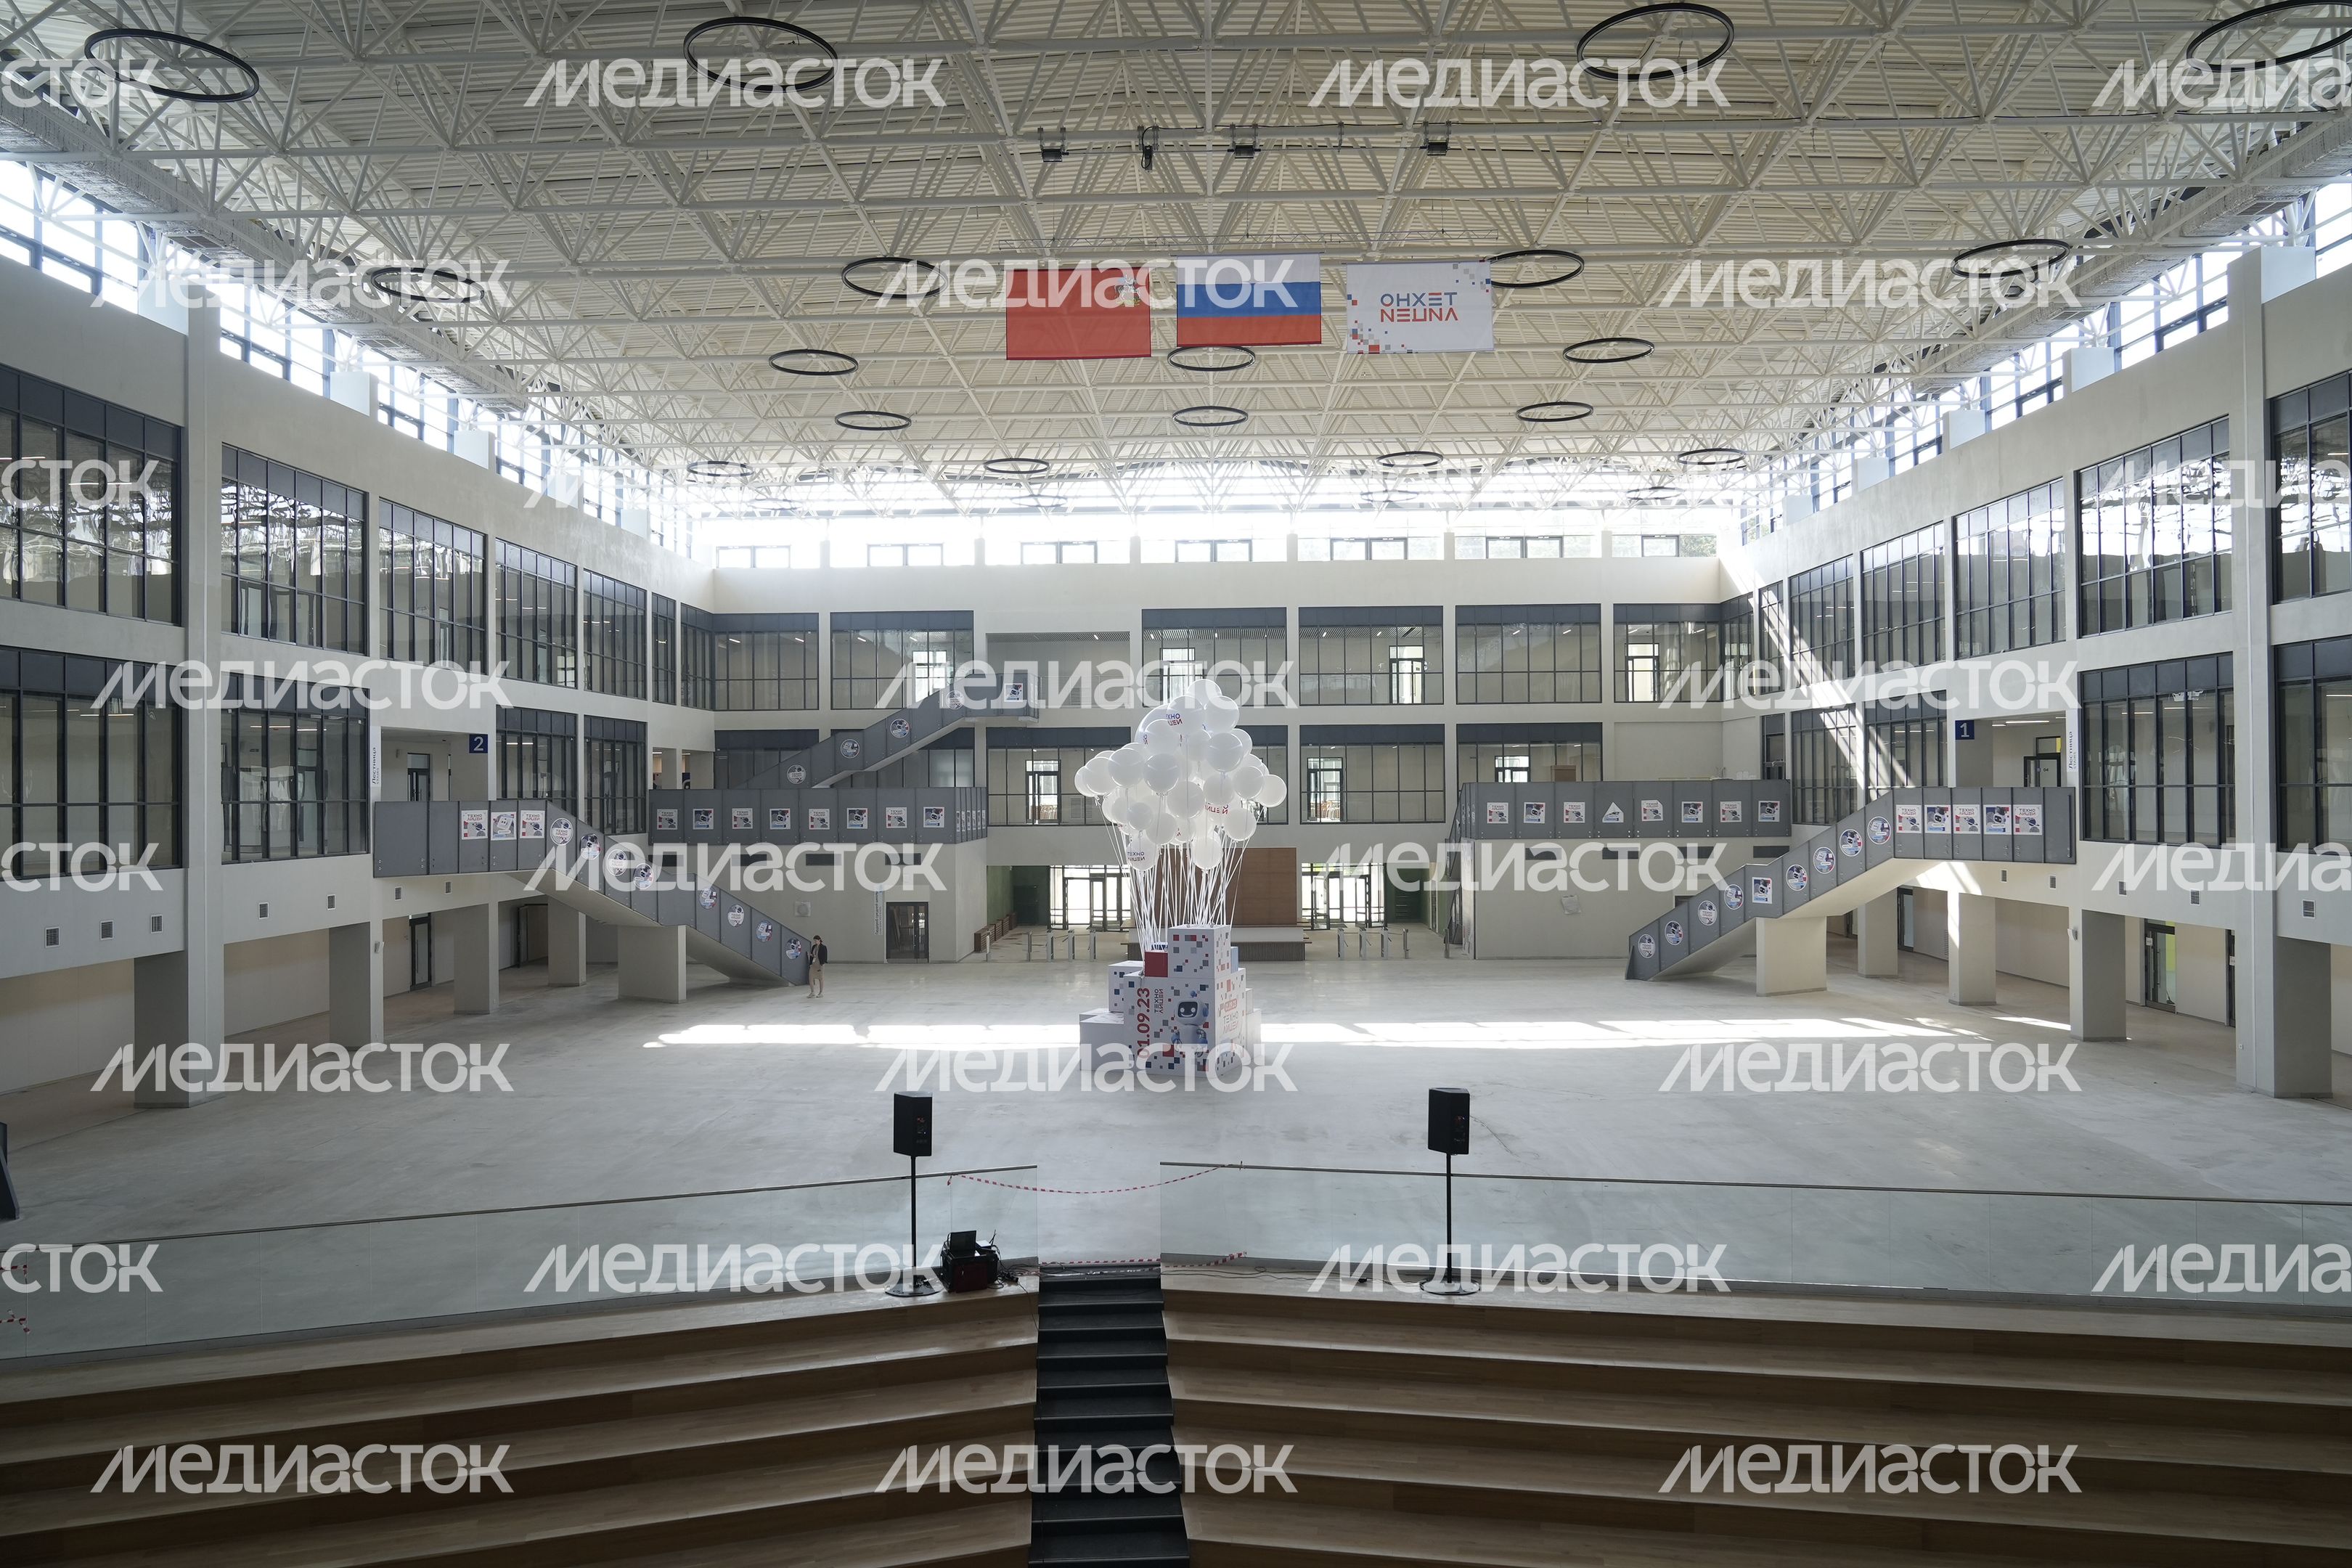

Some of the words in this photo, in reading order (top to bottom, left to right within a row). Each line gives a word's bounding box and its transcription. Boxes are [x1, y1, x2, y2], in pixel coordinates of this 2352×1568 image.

[1959, 722, 1970, 738] 1
[473, 736, 484, 751] 2
[1136, 988, 1150, 1058] 01.09.23
